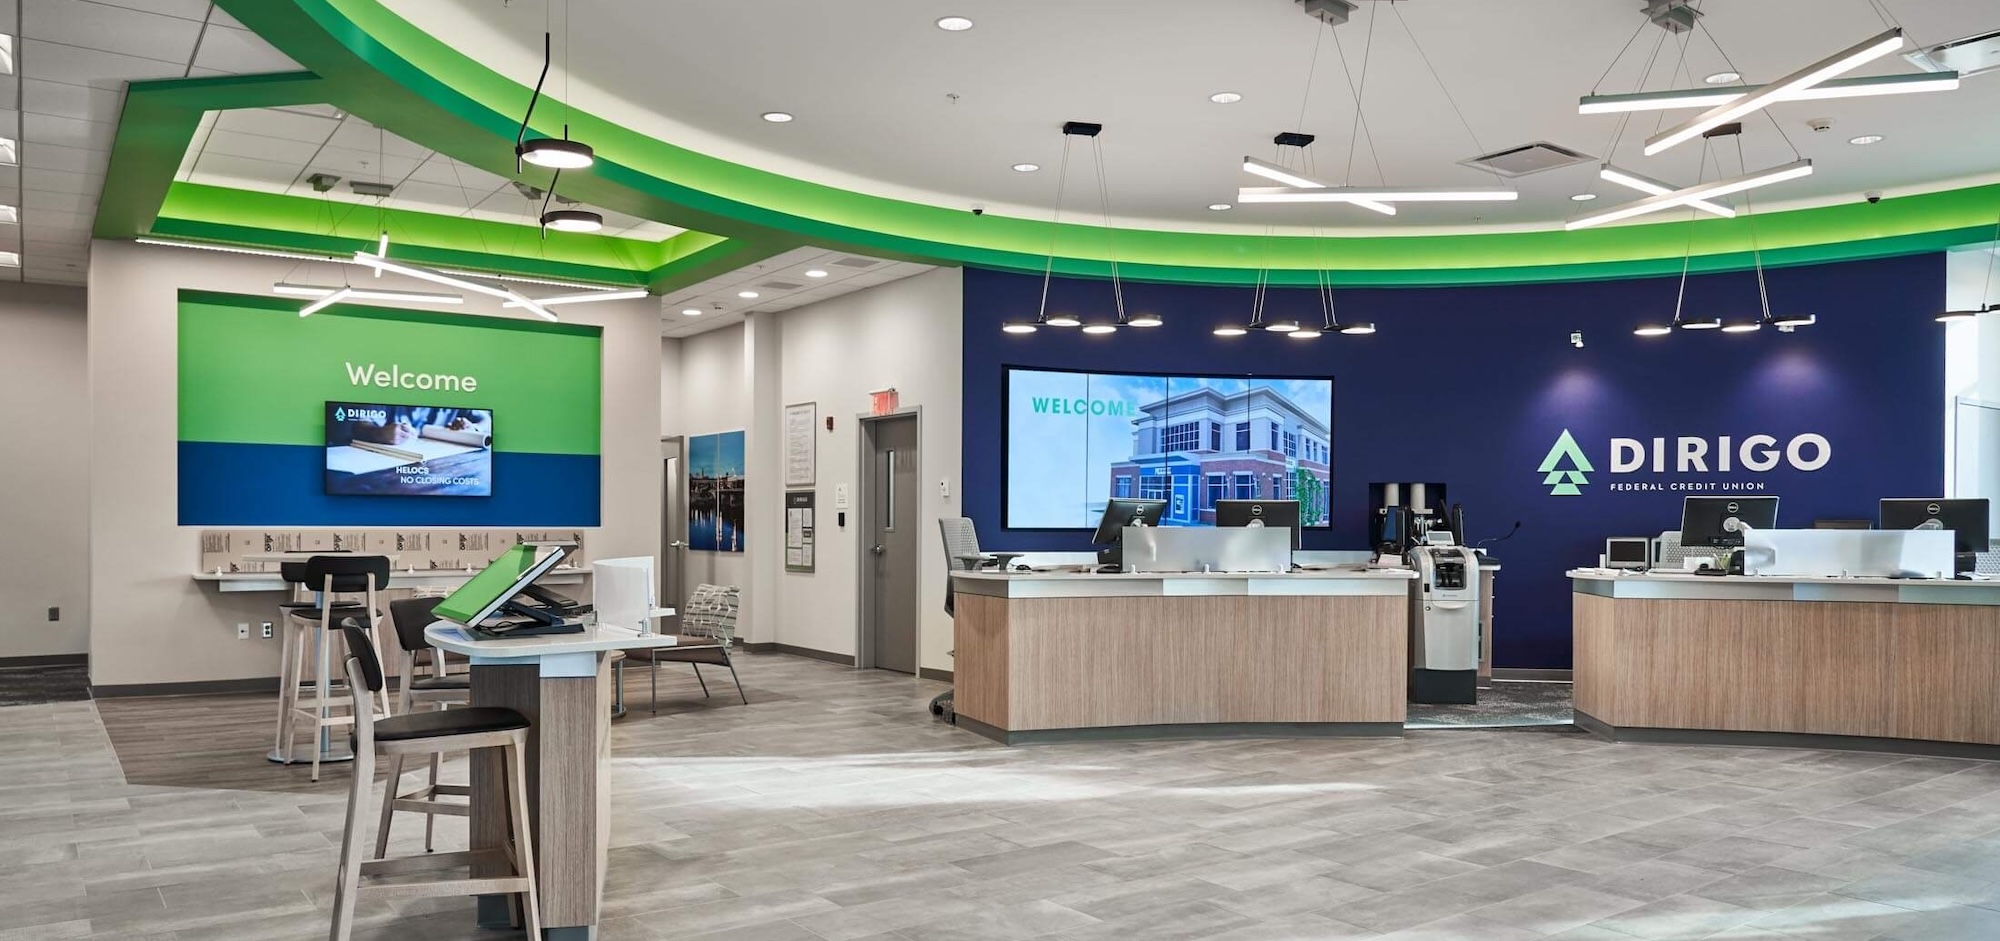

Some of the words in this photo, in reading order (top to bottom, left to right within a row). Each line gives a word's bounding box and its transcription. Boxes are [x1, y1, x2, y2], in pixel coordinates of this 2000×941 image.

[345, 361, 478, 392] Welcome
[1032, 397, 1135, 416] WELCOME
[348, 408, 387, 419] DIRIGO
[1610, 432, 1831, 473] DIRIGO
[396, 466, 430, 475] HELOCS
[400, 476, 414, 484] NO
[415, 477, 451, 485] CLOSING
[452, 478, 480, 486] COSTS
[1610, 483, 1664, 491] FEDERAL
[1670, 482, 1716, 491] CREDIT
[1722, 482, 1765, 490] UNION
